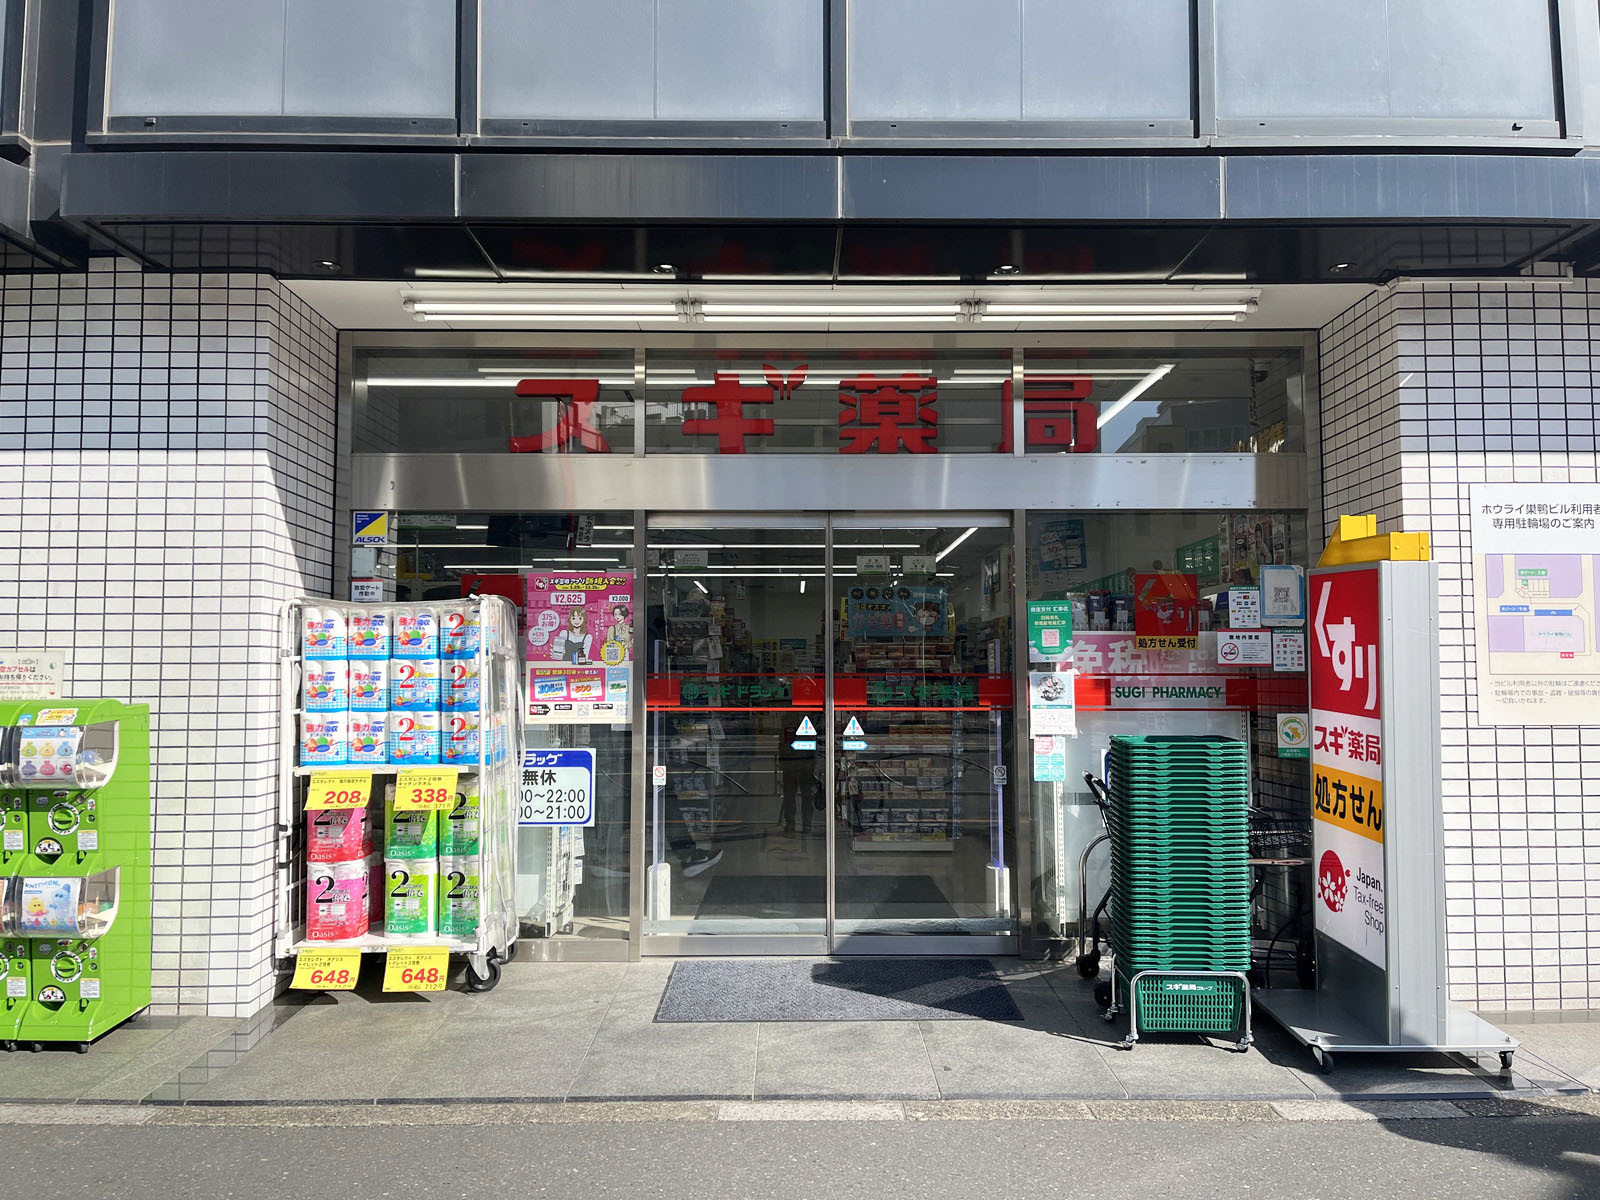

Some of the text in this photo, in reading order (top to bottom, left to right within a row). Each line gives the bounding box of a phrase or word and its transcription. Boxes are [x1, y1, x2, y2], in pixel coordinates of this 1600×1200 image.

[1492, 518, 1595, 529] 専用駐輪場のご案内
[1138, 638, 1196, 648] 処方せん受付
[1314, 581, 1376, 710] くすり
[1115, 686, 1222, 699] SUGI PHARMACY
[1314, 726, 1381, 765] スギ薬局
[522, 769, 557, 786] 無休
[1315, 773, 1382, 831] 処方せん
[446, 846, 467, 854] Oasis
[1357, 867, 1383, 893] Japan.
[1354, 886, 1384, 914] Tax-free
[388, 924, 409, 932] Oasis
[1365, 910, 1384, 935] Shop
